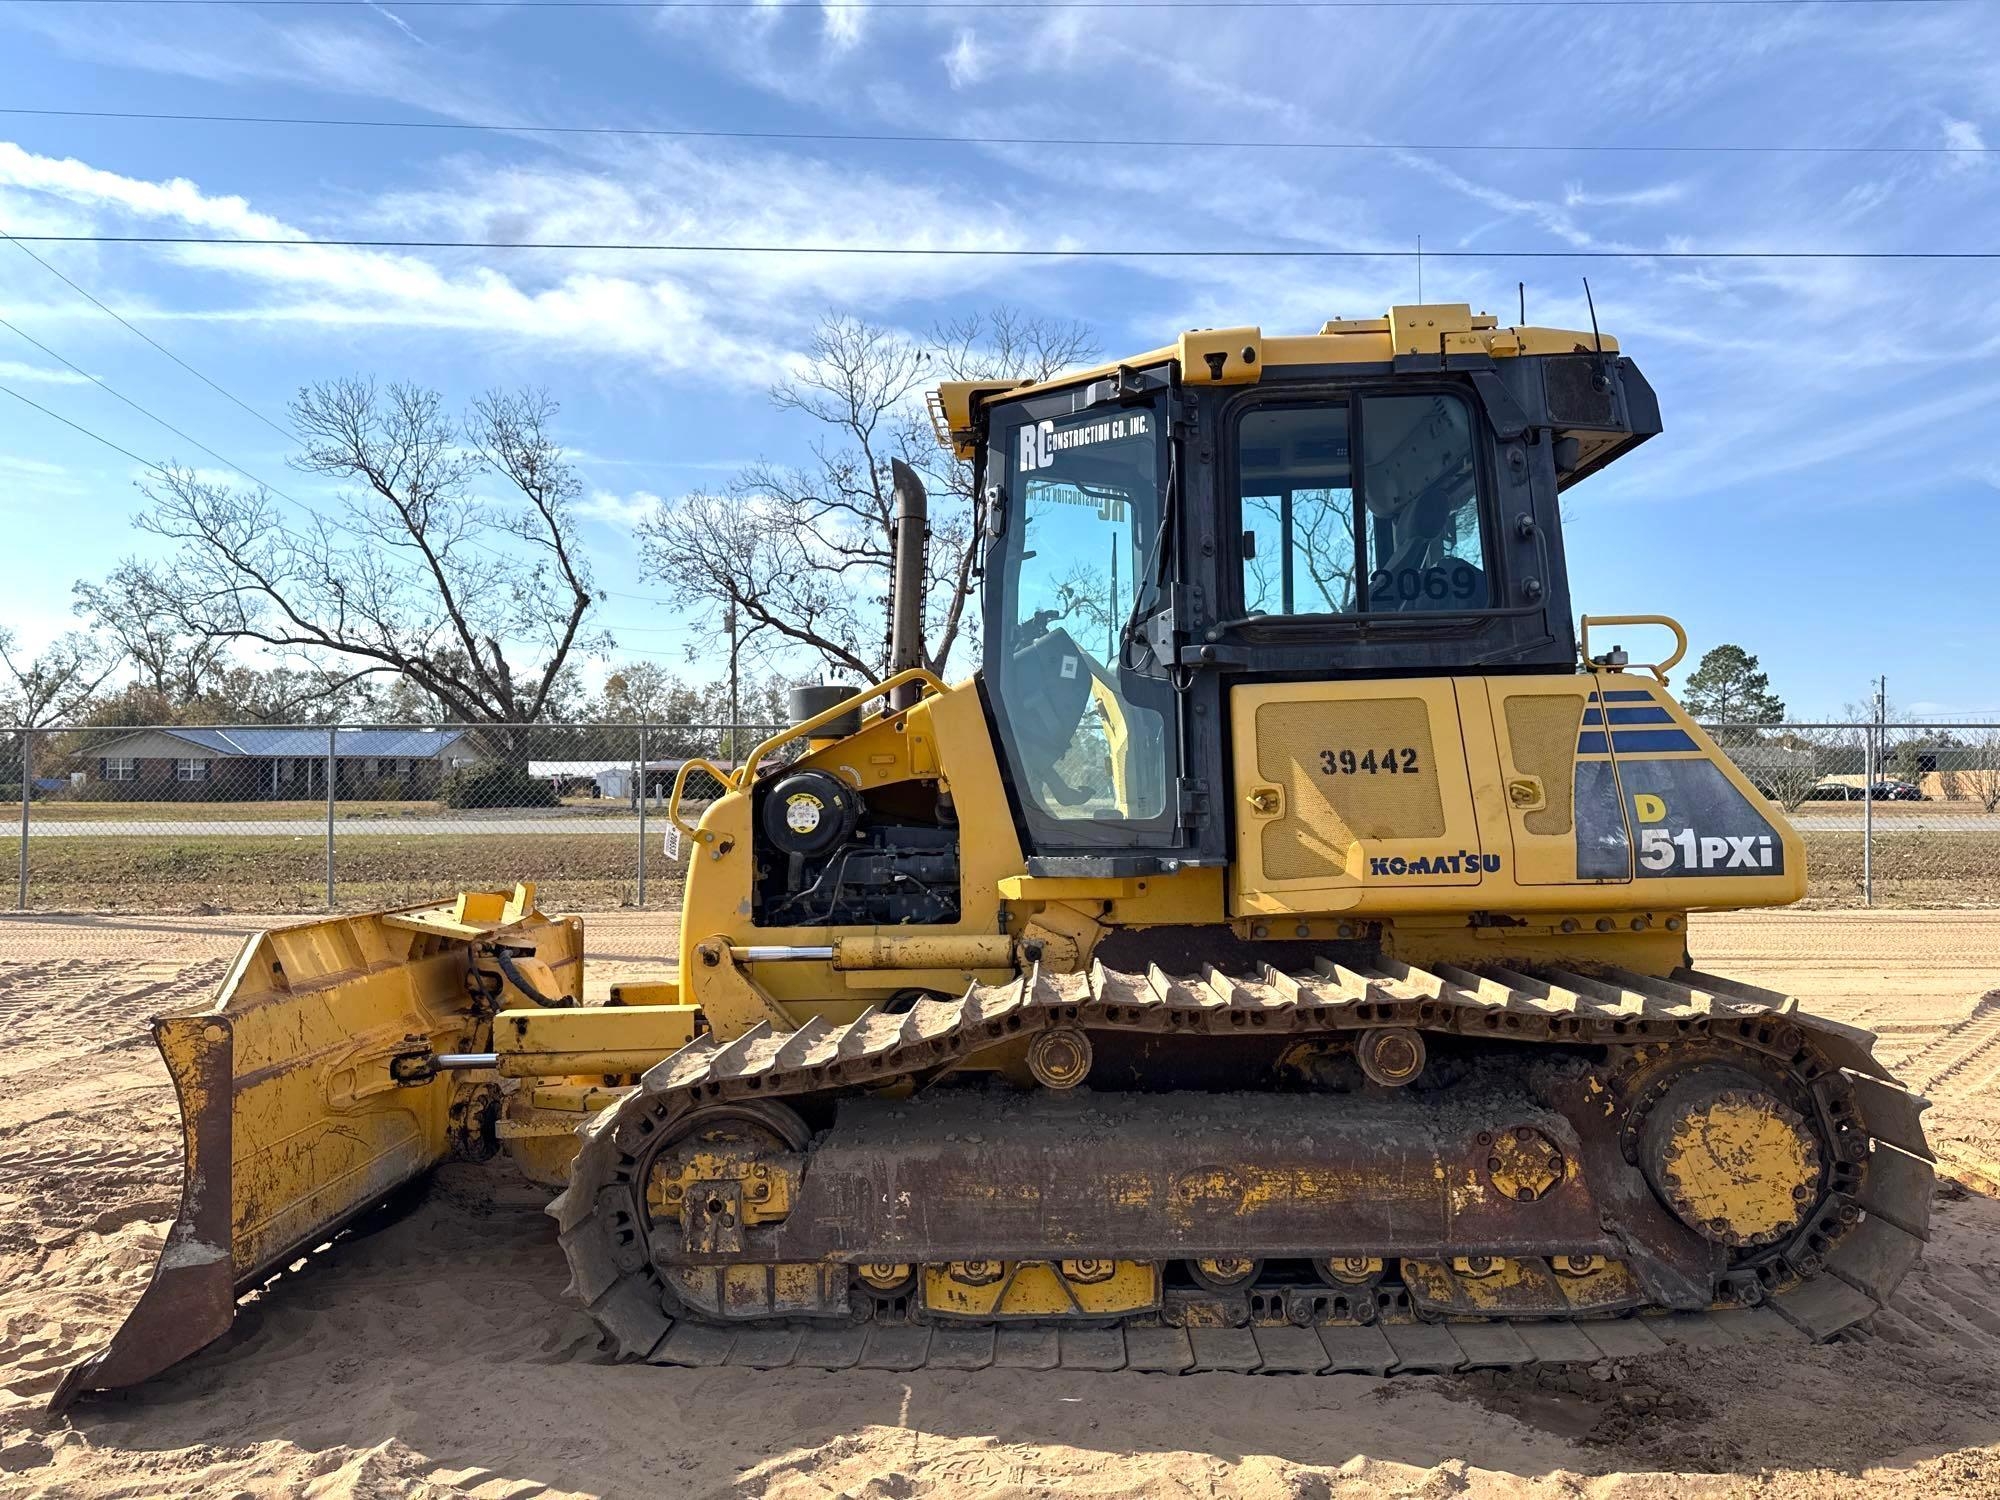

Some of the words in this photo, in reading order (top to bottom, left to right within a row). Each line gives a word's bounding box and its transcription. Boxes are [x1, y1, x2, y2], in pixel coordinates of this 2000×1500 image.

[1019, 420, 1054, 472] RC
[1048, 423, 1110, 451] CONSTRUCTION
[1112, 421, 1127, 438] CO.
[1130, 415, 1149, 434] INC.
[1369, 566, 1476, 601] 2069
[1319, 748, 1419, 775] 39442
[1633, 794, 1667, 823] D
[1369, 850, 1501, 876] KOMATSU
